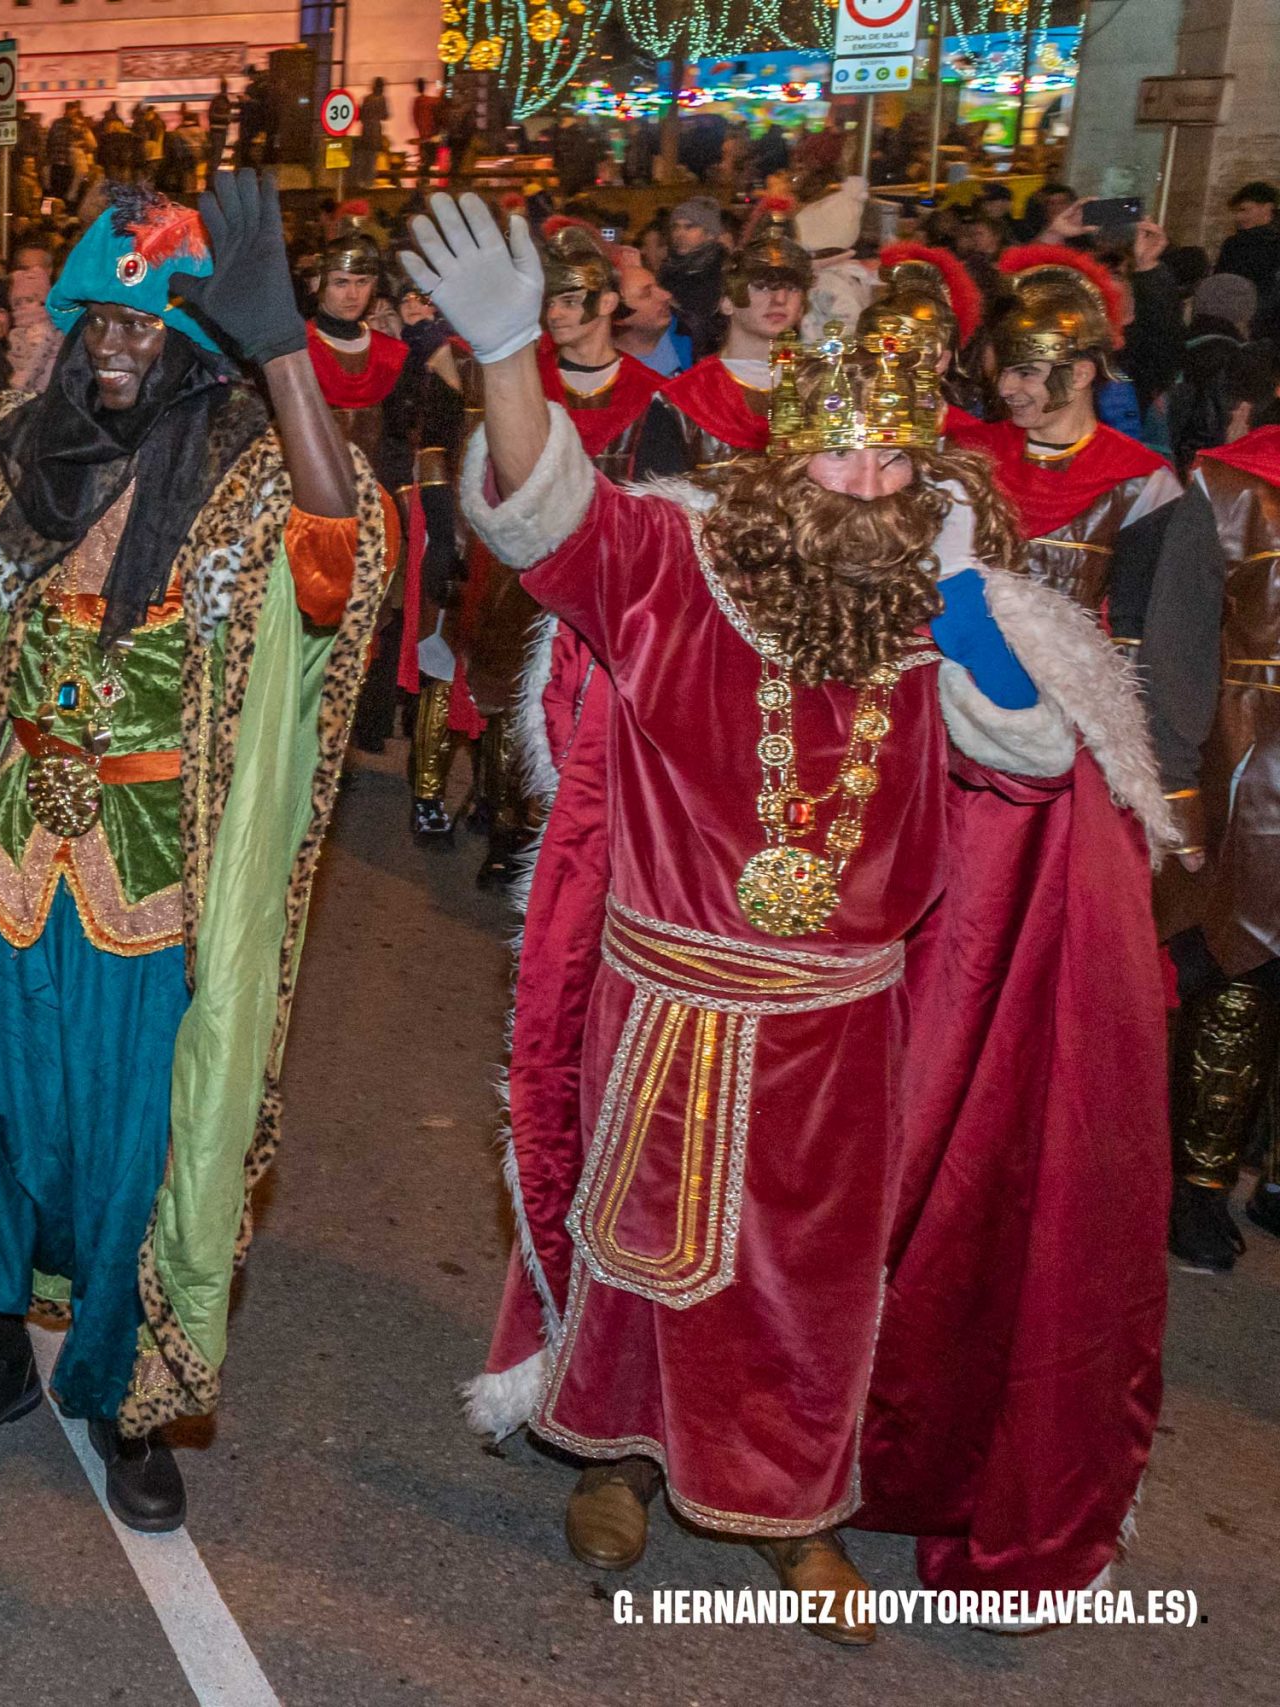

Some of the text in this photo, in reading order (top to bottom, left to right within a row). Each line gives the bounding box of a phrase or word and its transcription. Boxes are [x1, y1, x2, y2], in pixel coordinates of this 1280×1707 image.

[882, 31, 910, 39] BAJAS
[852, 41, 899, 50] EMISIONES
[329, 104, 350, 120] 30
